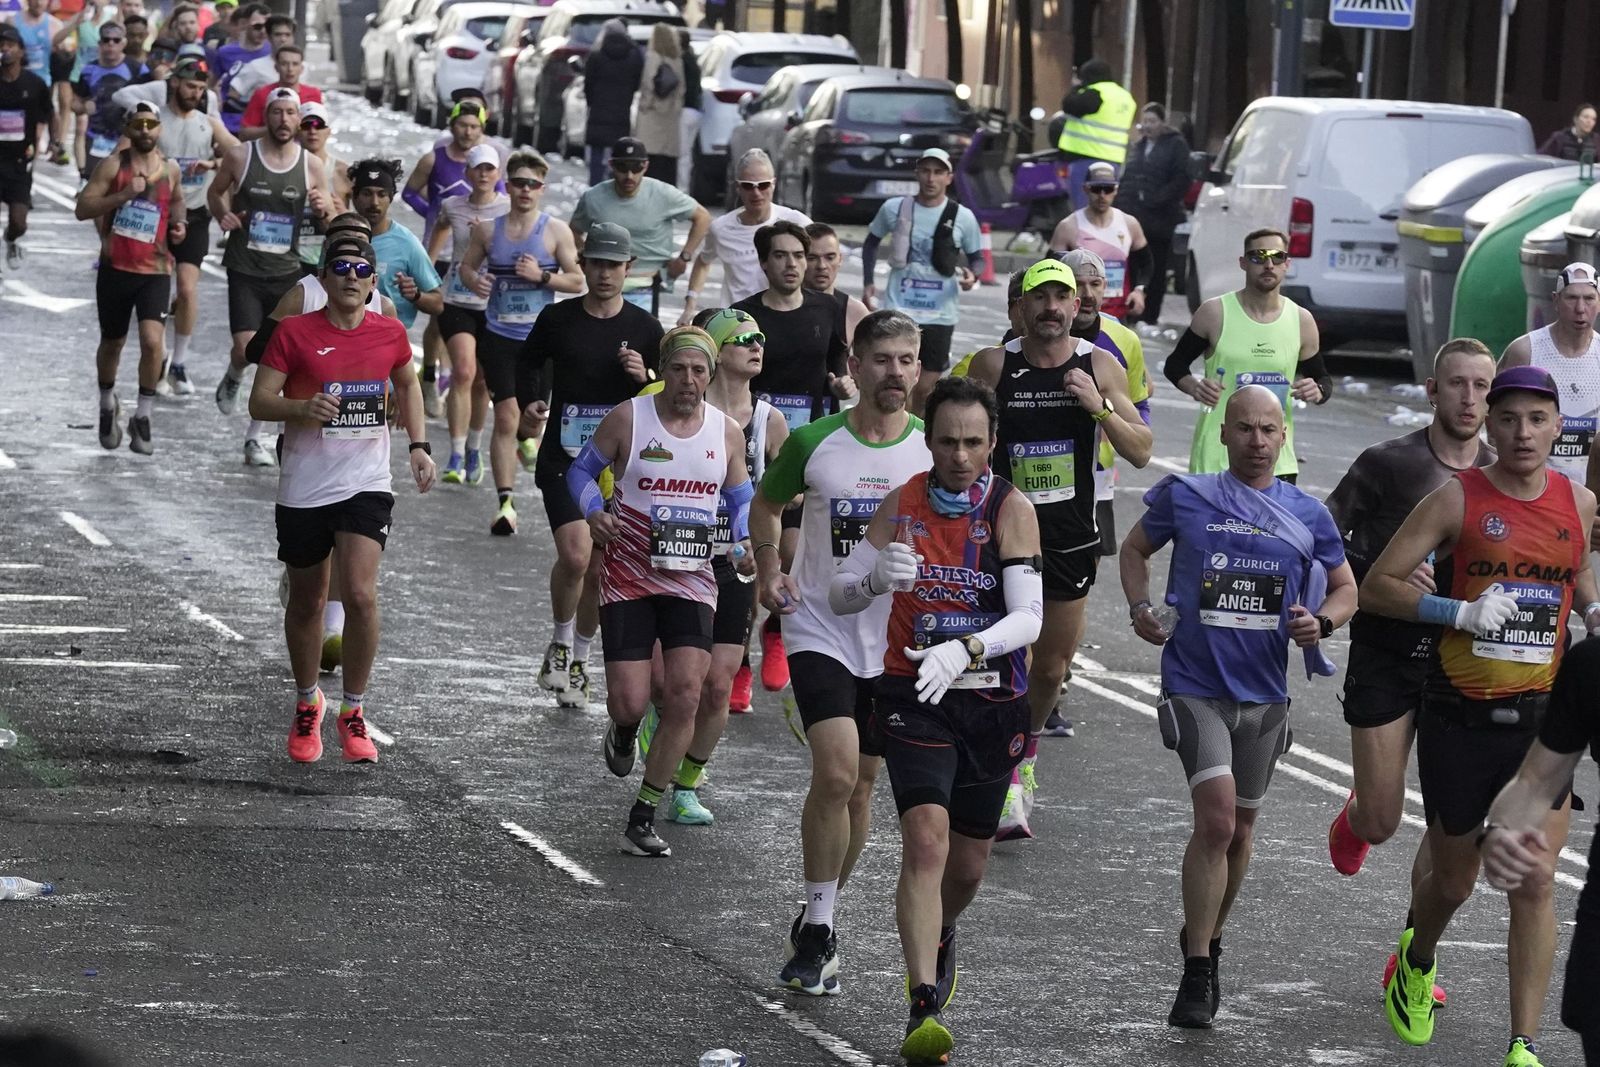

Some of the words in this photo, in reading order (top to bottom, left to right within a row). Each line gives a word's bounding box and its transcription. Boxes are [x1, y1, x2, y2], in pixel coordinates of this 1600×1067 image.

[507, 303, 531, 313] SHEA
[904, 298, 936, 308] THOMAS
[1256, 375, 1286, 384] ZURICH
[346, 383, 381, 394] ZURICH
[1014, 391, 1033, 399] CLUB
[346, 401, 366, 412] 4742
[775, 396, 807, 407] ZURICH
[332, 412, 379, 427] SAMUEL
[1562, 419, 1592, 429] ZURICH
[1561, 434, 1577, 443] 5027
[1029, 443, 1067, 455] ZURICH
[1554, 444, 1583, 456] KEITH
[1031, 463, 1052, 473] 1669
[856, 482, 872, 490] CITY
[859, 477, 889, 485] MADRID
[1024, 474, 1061, 490] FURIO
[675, 510, 709, 522] ZURICH
[675, 527, 696, 540] 5186
[658, 540, 708, 557] PAQUITO
[1232, 557, 1280, 571] ZURICH
[1466, 560, 1508, 578] CDA
[1231, 579, 1256, 592] 4791
[1511, 587, 1554, 600] ZURICH
[1216, 593, 1268, 613] ANGEL
[1504, 629, 1556, 646] HIDALGO
